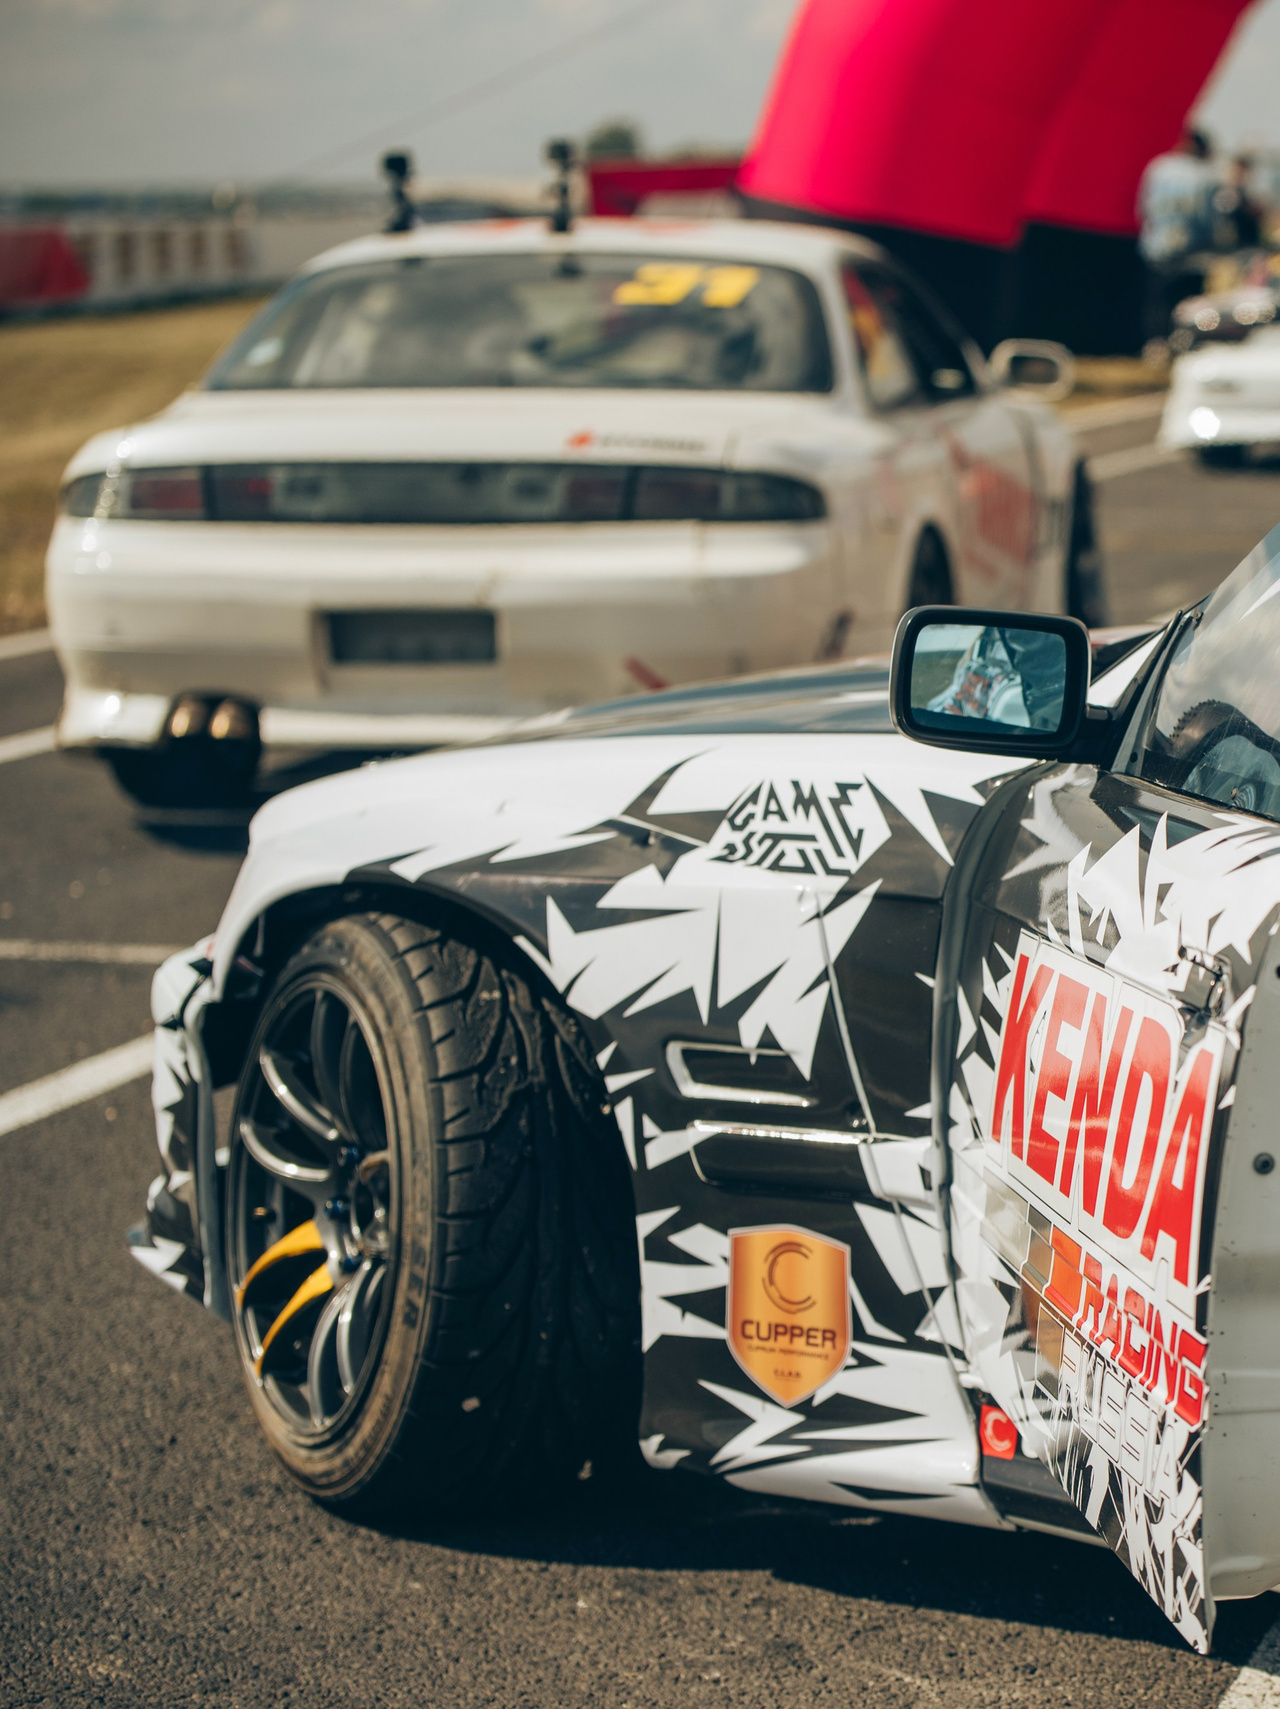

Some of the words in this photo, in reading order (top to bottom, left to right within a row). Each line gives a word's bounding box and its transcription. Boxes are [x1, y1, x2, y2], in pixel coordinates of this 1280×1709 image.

[727, 780, 864, 862] GAME
[992, 953, 1214, 1288] KENDA
[741, 1319, 838, 1350] CUPPER
[1074, 1251, 1209, 1428] RACING
